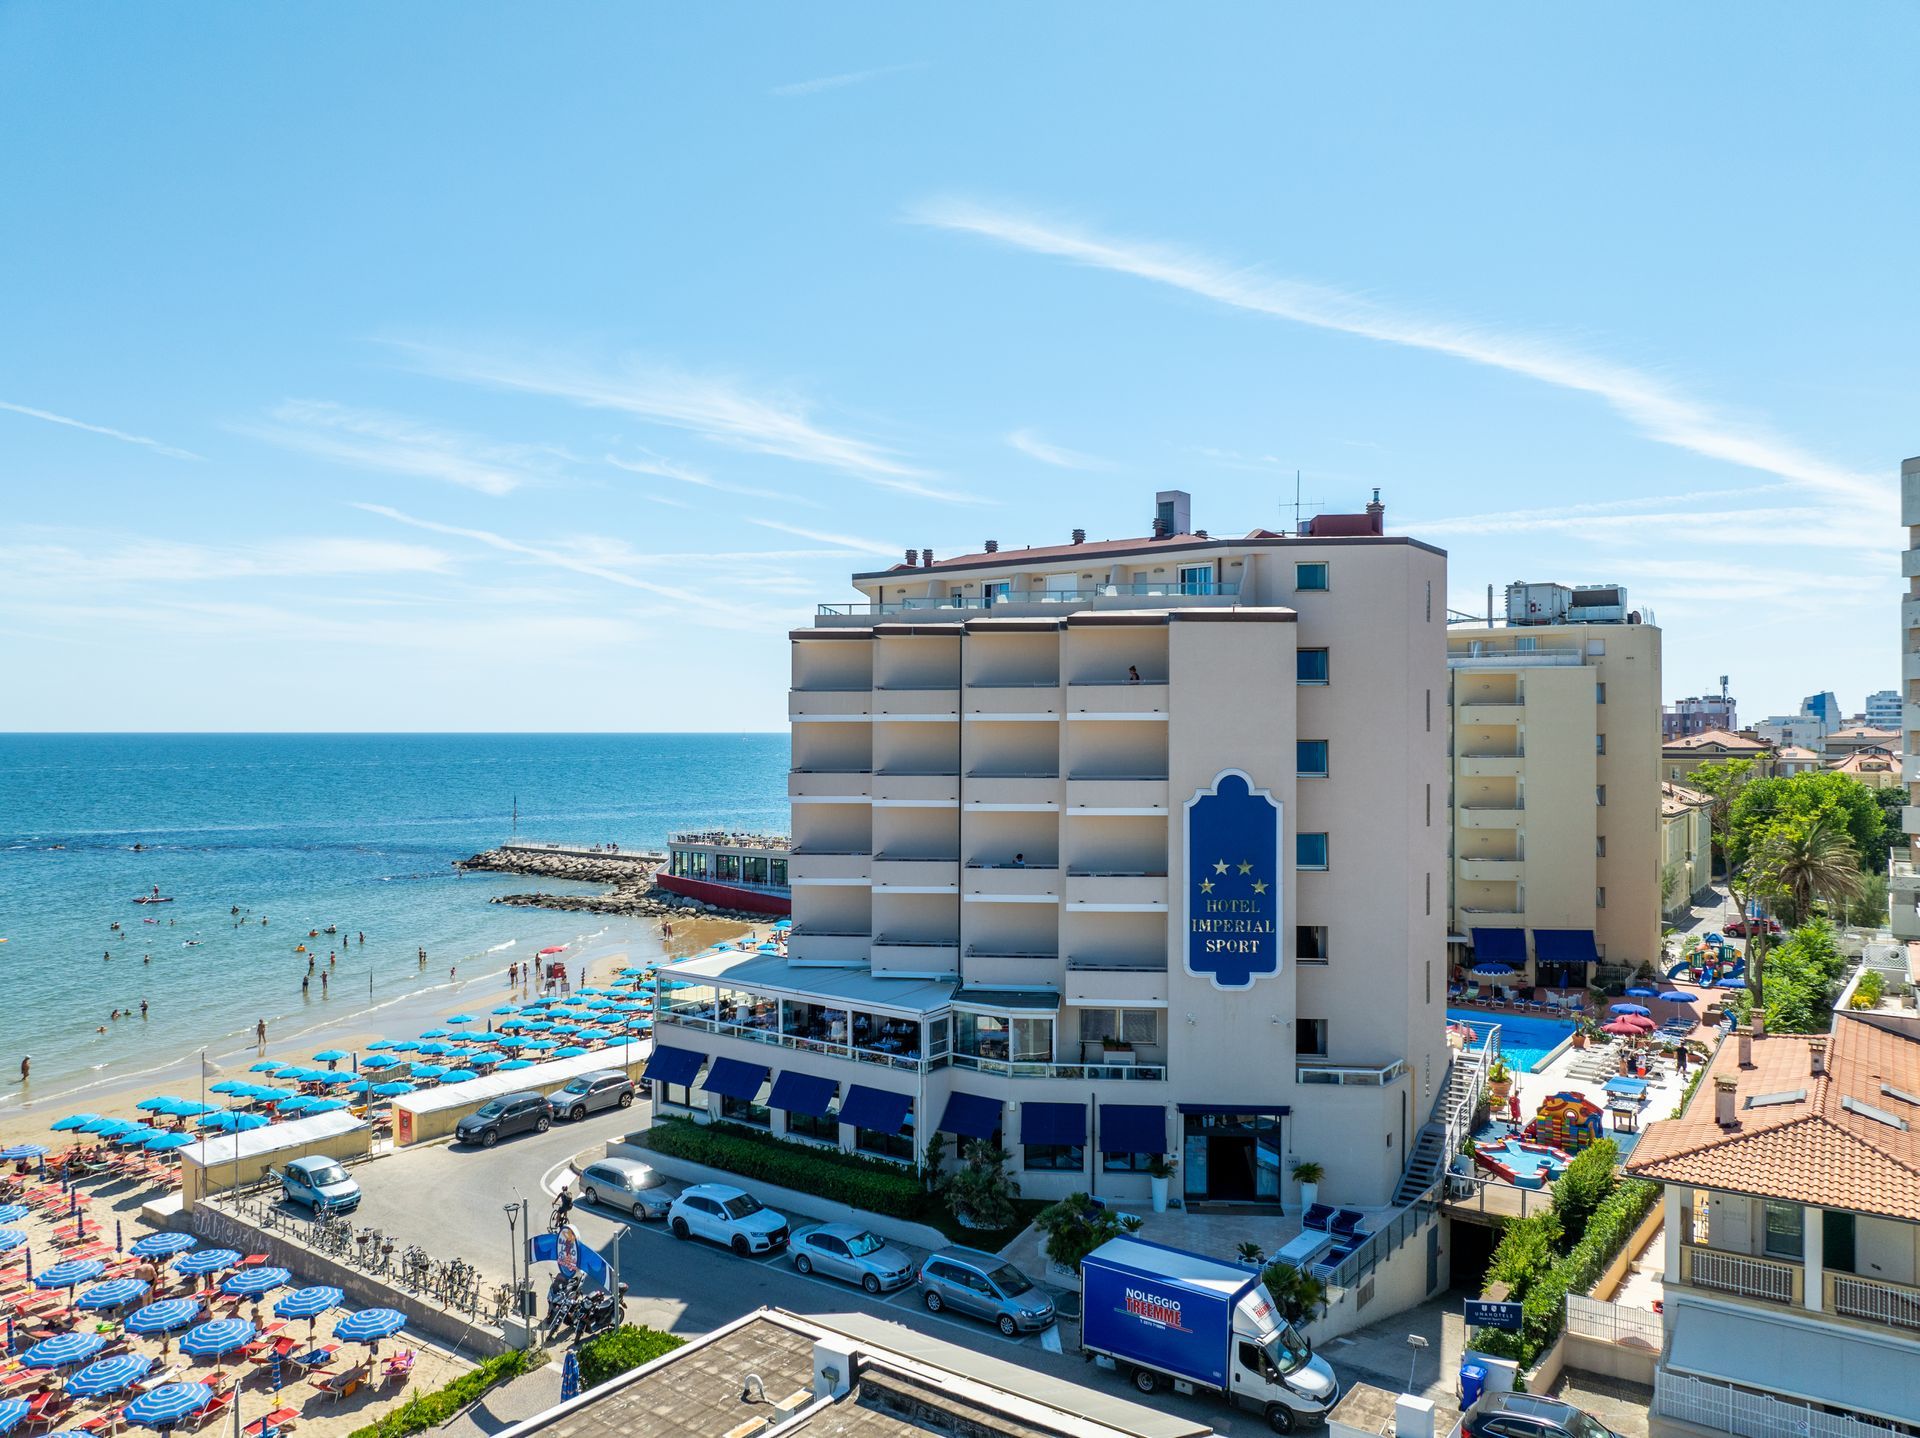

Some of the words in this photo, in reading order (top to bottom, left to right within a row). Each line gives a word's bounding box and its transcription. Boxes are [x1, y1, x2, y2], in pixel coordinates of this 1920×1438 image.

[1206, 899, 1261, 913] HOTEL
[1191, 919, 1275, 933] IMPERIAL
[1206, 939, 1260, 953] SPORT
[1126, 1287, 1181, 1311] NOLEGGIO
[1126, 1297, 1181, 1327] TREEMME
